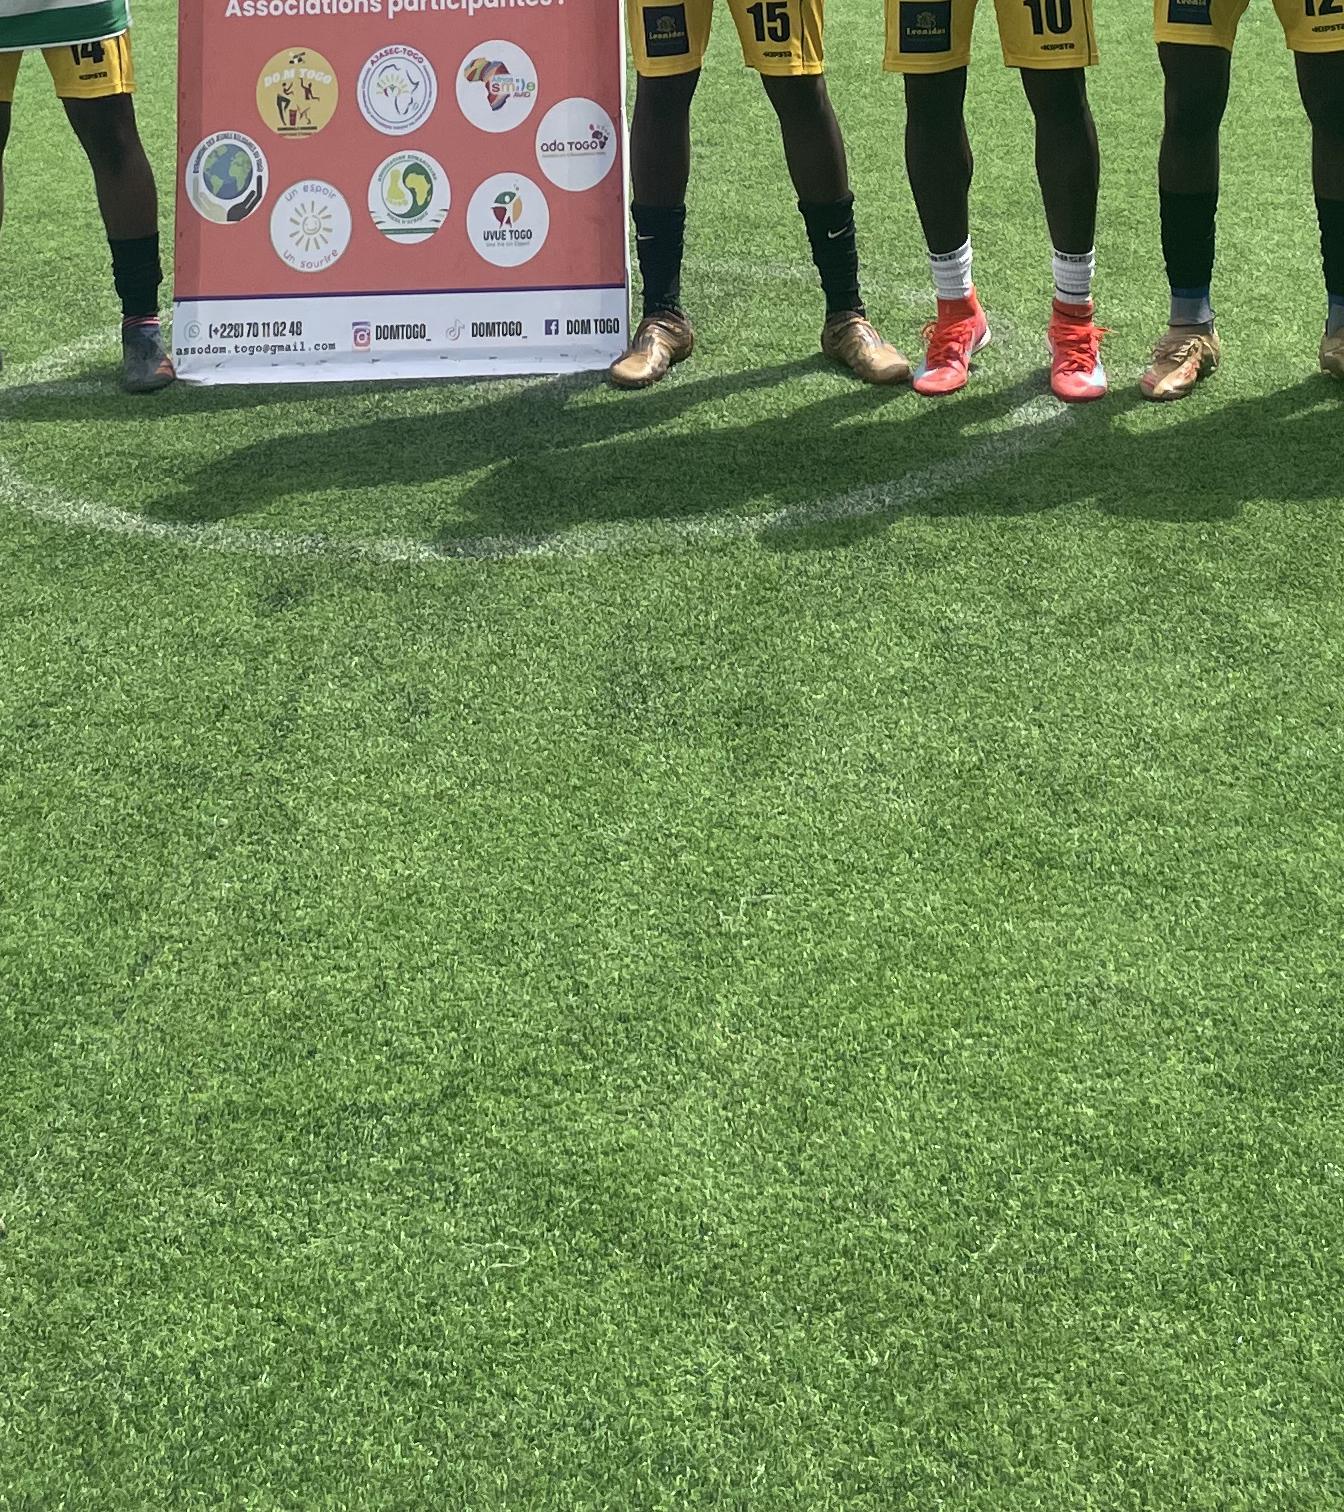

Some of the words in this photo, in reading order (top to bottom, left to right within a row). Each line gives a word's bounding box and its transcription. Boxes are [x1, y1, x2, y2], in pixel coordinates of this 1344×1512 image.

[746, 1, 791, 43] 15
[906, 27, 946, 36] Leonidas
[69, 41, 106, 66] 14
[299, 68, 333, 85] TOGO
[540, 140, 565, 152] ada
[567, 140, 597, 151] TOGO
[303, 184, 336, 199] espoir
[508, 228, 533, 240] TOGO
[300, 249, 339, 268] sourire
[208, 323, 244, 339] (+228)
[246, 322, 259, 338] 70
[261, 322, 270, 338] 11
[272, 321, 286, 337] 02
[288, 321, 303, 336] 48
[566, 319, 591, 335] DOM
[594, 318, 620, 334] TOGO
[176, 340, 336, 356] assodom.togo@gmail.com
